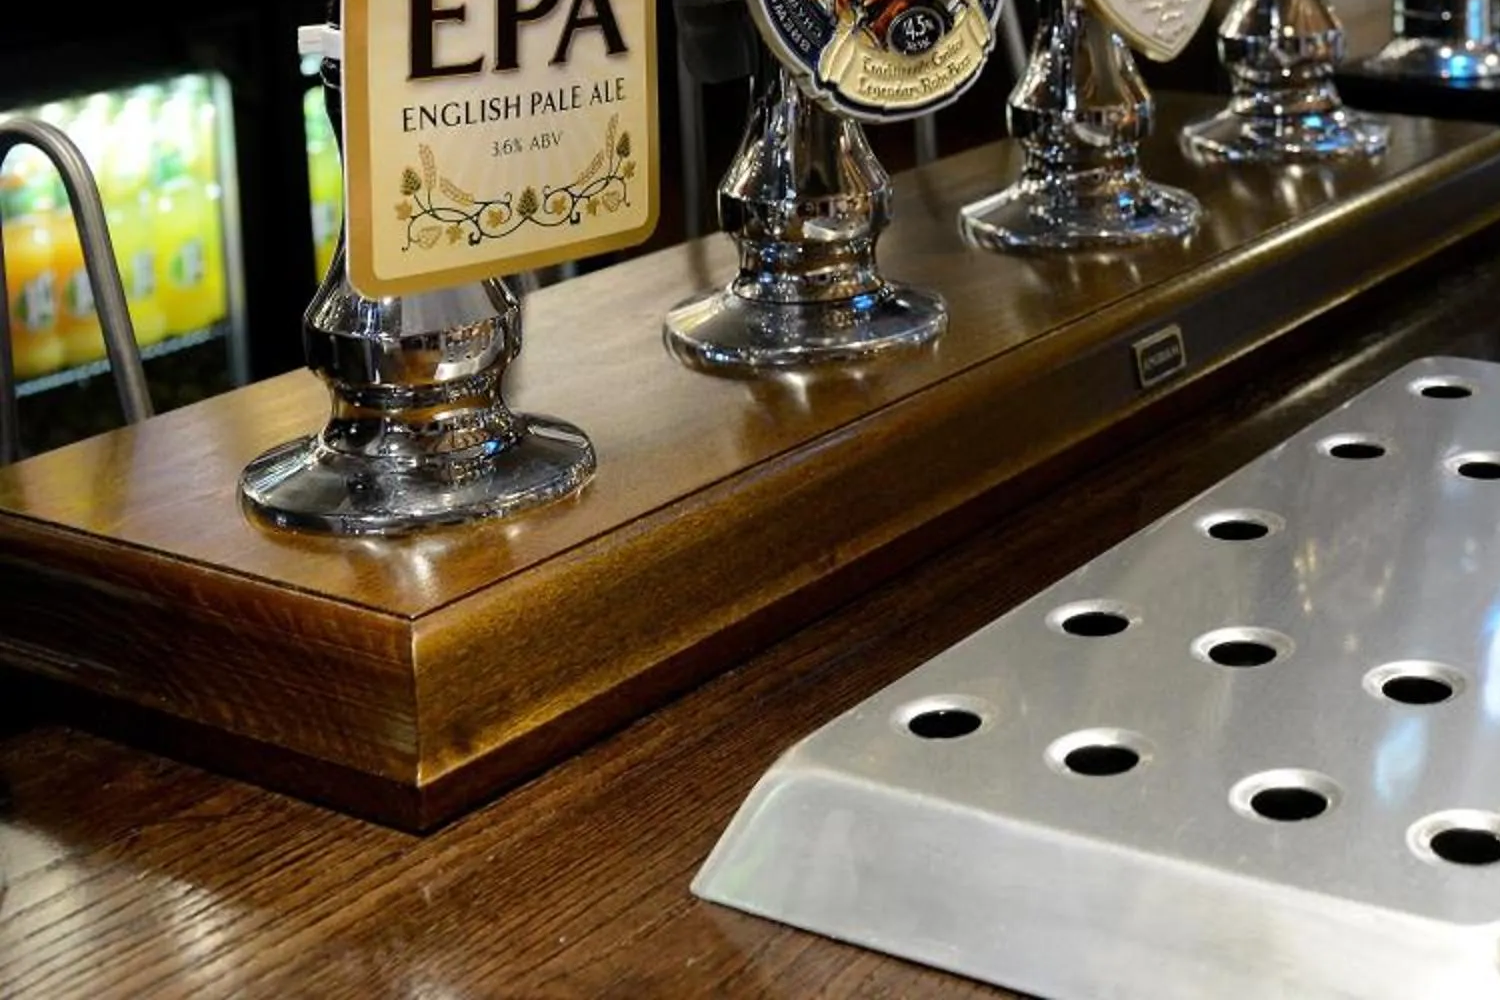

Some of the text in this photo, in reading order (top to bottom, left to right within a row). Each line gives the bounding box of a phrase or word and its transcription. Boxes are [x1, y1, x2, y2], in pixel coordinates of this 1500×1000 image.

[402, 77, 626, 133] ENGLISH PALE ALE
[529, 130, 564, 151] ABV
